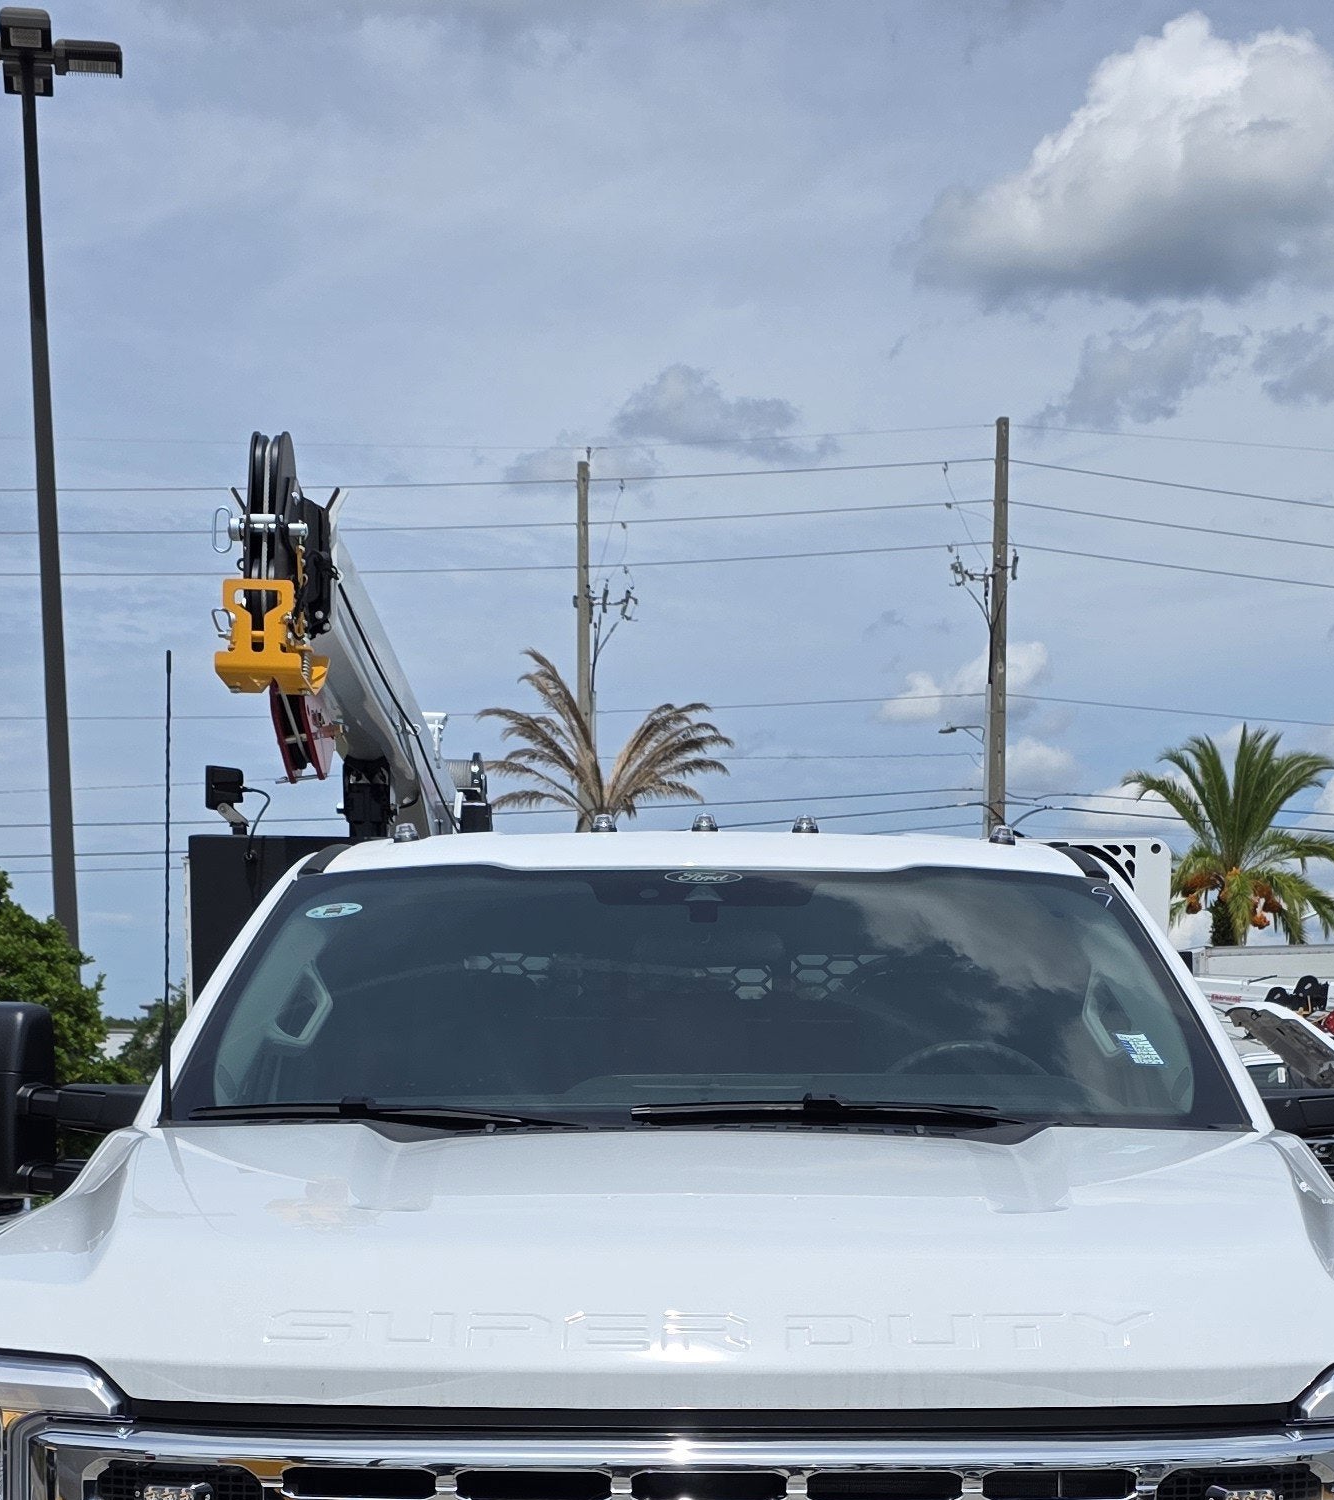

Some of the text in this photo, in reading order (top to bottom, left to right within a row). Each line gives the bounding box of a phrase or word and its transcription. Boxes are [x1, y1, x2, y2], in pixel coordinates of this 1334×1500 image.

[677, 872, 729, 882] Ford
[263, 1308, 1155, 1353] SUPER DUTY
